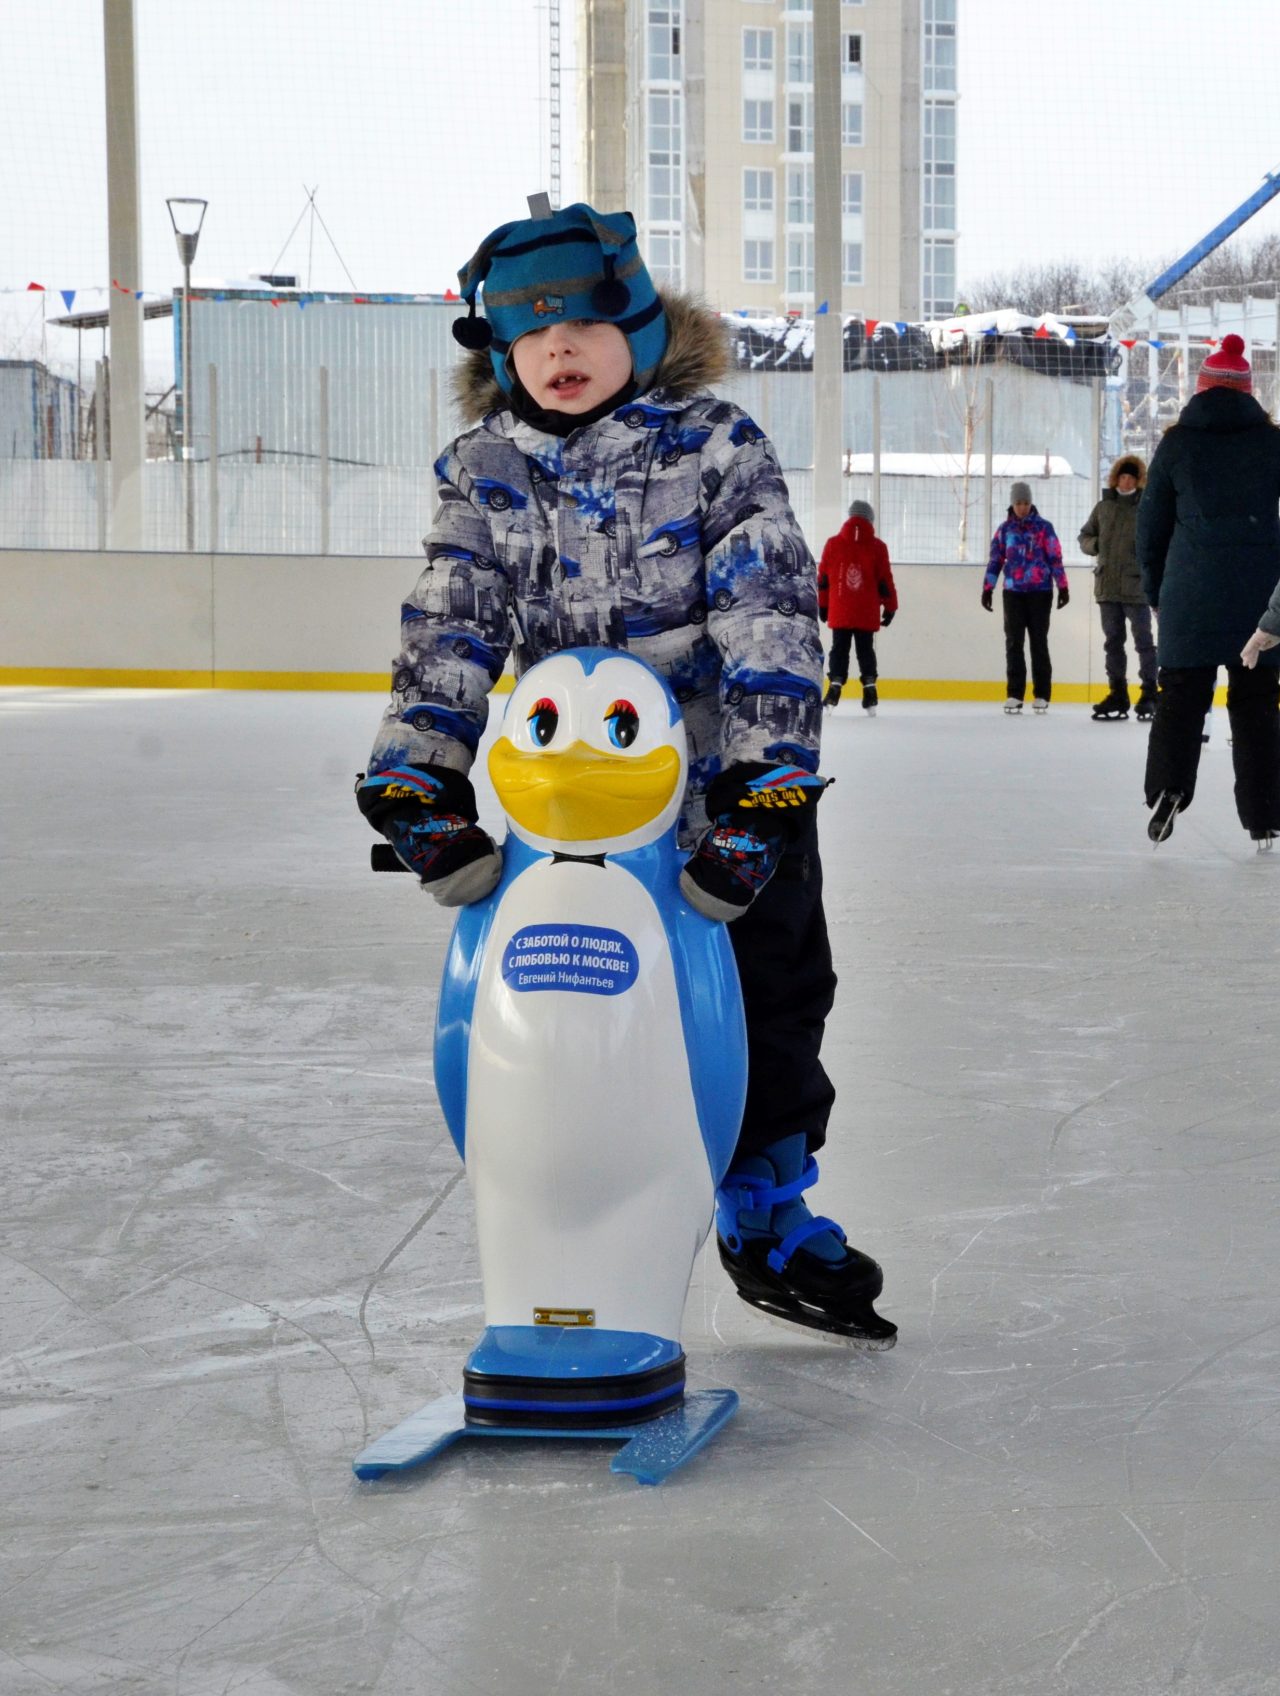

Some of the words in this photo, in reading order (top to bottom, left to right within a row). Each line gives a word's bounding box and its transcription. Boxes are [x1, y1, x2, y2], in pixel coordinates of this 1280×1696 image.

[515, 938, 522, 949] С
[522, 934, 568, 948] ЗАБОТОЙ
[571, 936, 579, 947] О
[580, 936, 624, 954] ЛЮДЯХ.
[508, 956, 515, 968] С
[515, 953, 570, 967] ЛЮБОВЬЮ
[572, 954, 580, 966] К
[582, 957, 629, 973] МОСКВЕ!
[518, 971, 556, 985] Евгений
[558, 972, 614, 988] Нифантьев
